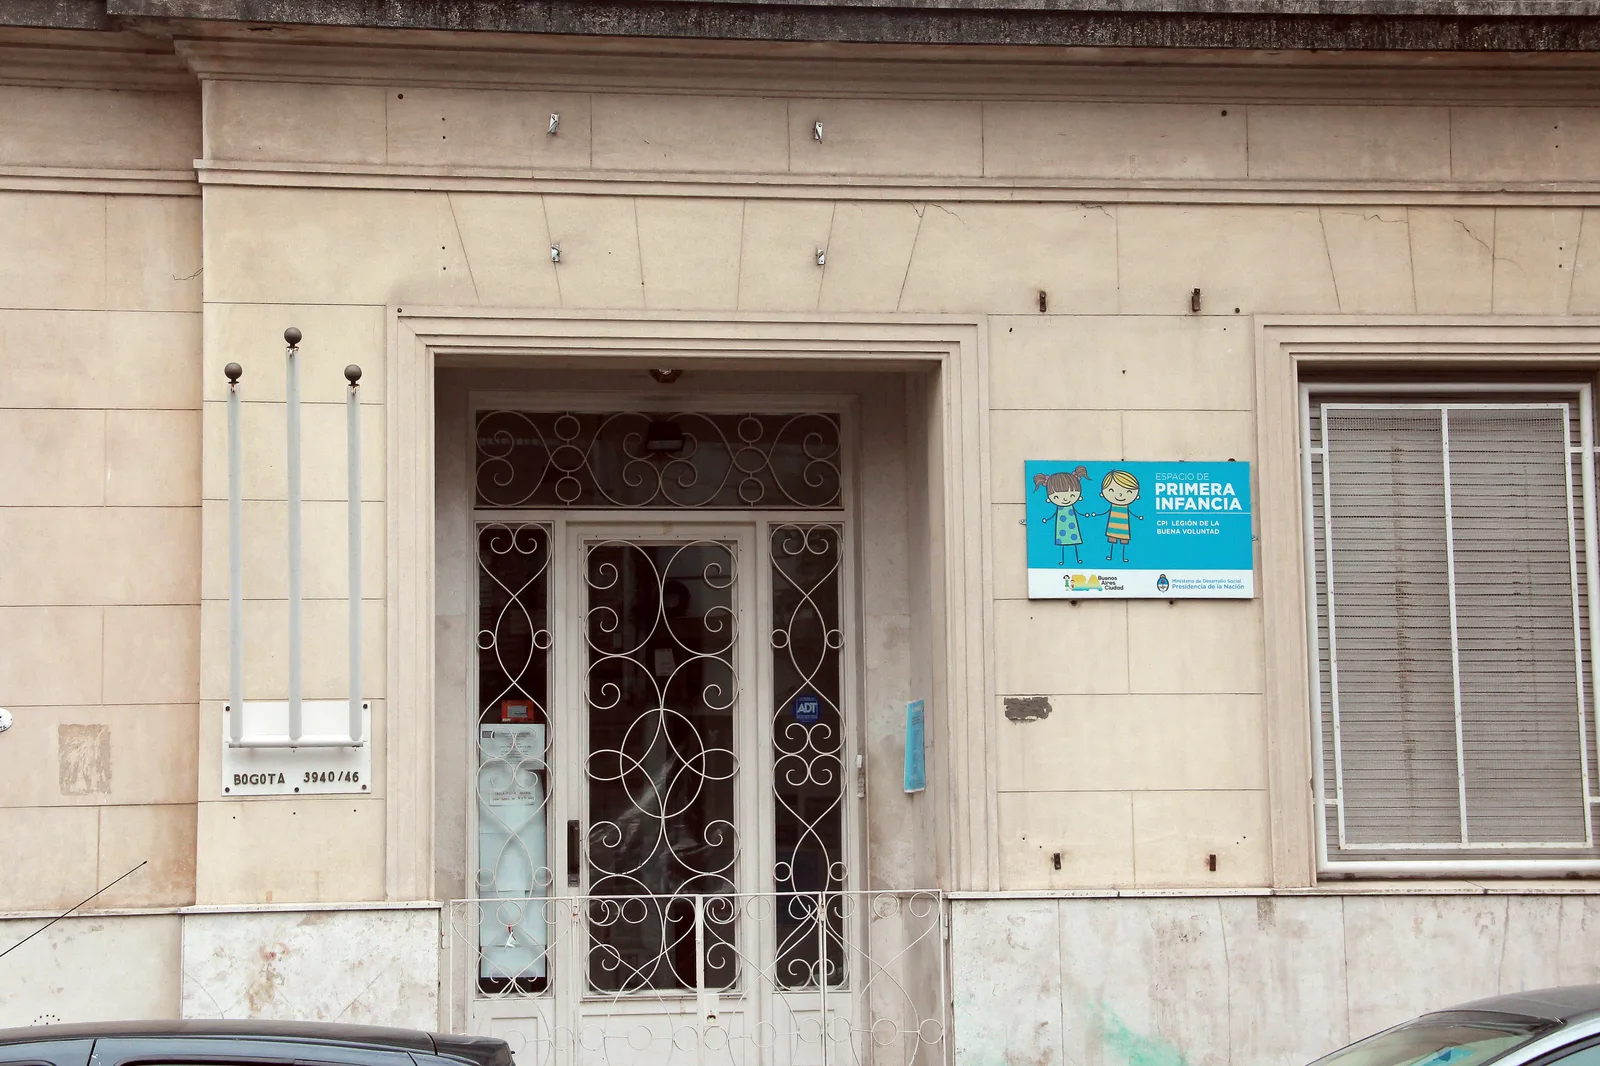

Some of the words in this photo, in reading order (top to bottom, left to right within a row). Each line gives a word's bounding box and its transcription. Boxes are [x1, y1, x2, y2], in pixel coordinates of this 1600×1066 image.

[1156, 483, 1236, 496] PRIMERA
[1156, 498, 1242, 510] INFANCIA
[796, 702, 817, 713] ADT
[234, 772, 285, 786] BOGOTA
[304, 771, 359, 783] 3940/46
